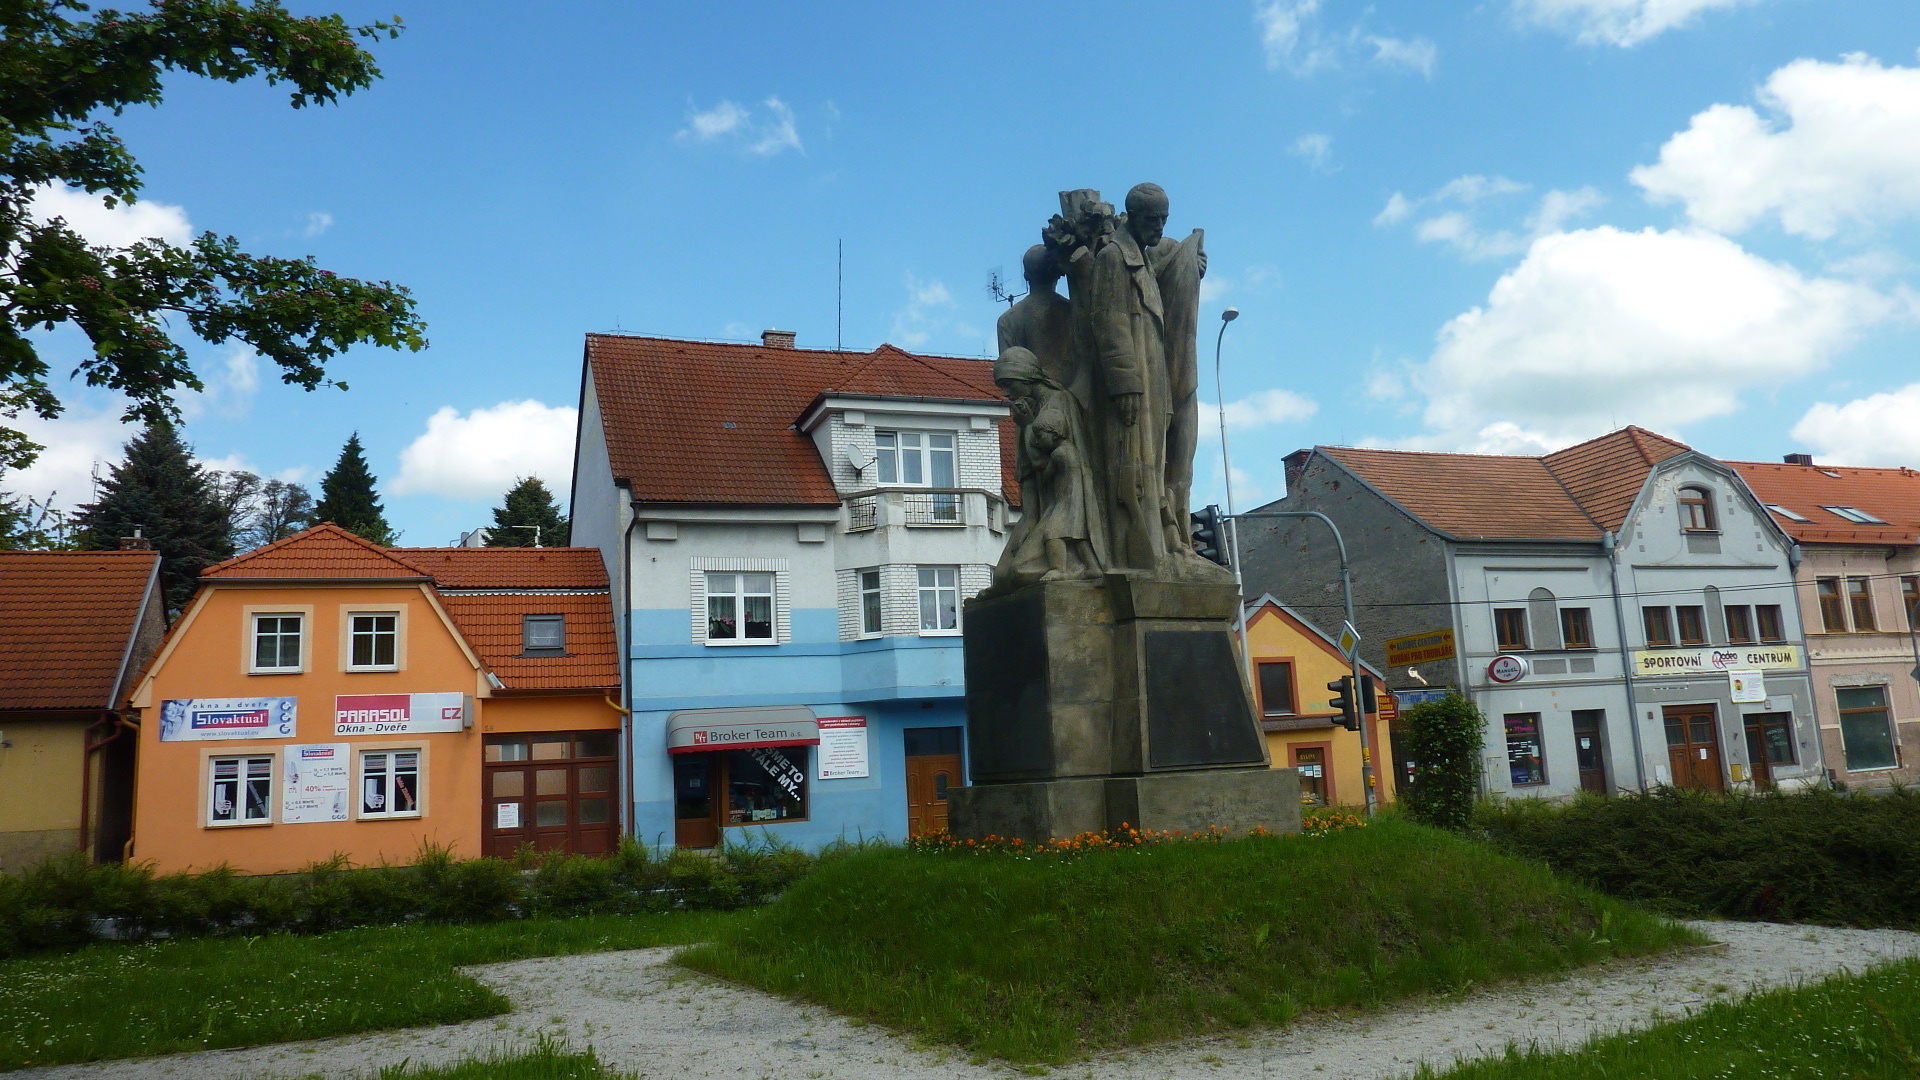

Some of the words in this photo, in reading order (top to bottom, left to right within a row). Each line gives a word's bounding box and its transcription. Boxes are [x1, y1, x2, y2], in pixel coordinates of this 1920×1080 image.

[1411, 651, 1423, 661] PRO
[1644, 653, 1702, 668] SPORTOVNÍ
[1747, 652, 1792, 664] CENTRUM
[337, 708, 410, 723] PARASOL
[441, 708, 462, 720] CZ
[337, 724, 365, 733] Okna
[376, 722, 408, 732] Dveře
[710, 730, 750, 742] Broker
[754, 729, 788, 739] Team
[788, 765, 804, 783] TO
